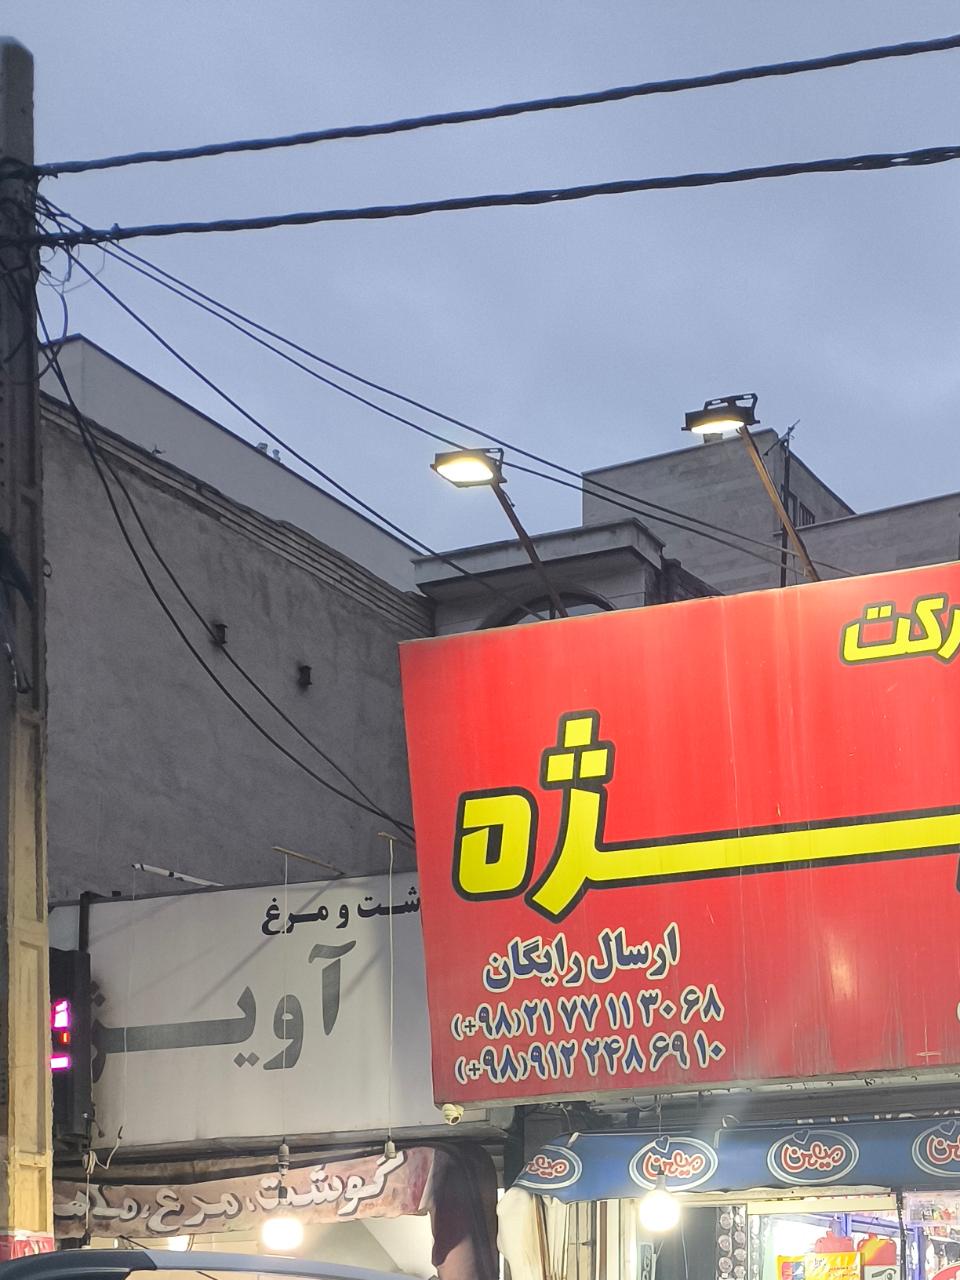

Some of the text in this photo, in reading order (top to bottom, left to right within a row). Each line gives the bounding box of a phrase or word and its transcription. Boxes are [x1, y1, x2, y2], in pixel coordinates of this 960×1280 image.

[261, 886, 421, 936] شت و مرغ
[483, 922, 680, 992] ارسال رایگان
[526, 1154, 570, 1179] میه
